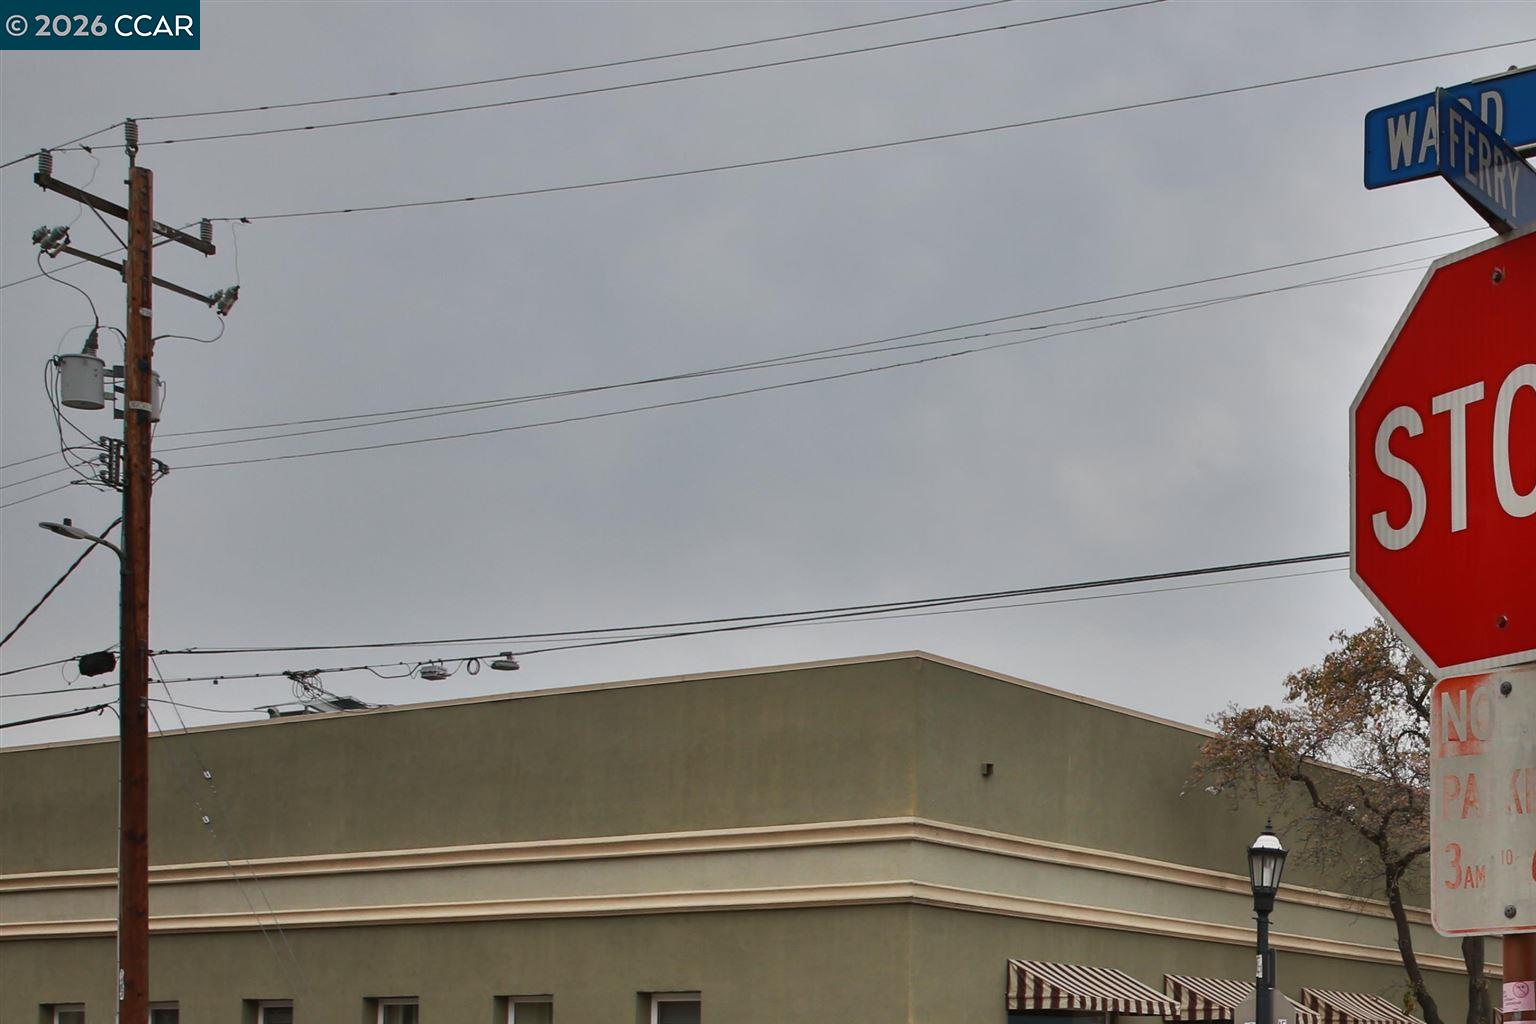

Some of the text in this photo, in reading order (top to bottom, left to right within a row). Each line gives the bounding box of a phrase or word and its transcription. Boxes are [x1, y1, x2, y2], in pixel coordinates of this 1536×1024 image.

[1387, 90, 1504, 171] WAD
[1449, 107, 1520, 218] FERRY
[1441, 686, 1495, 743] NO
